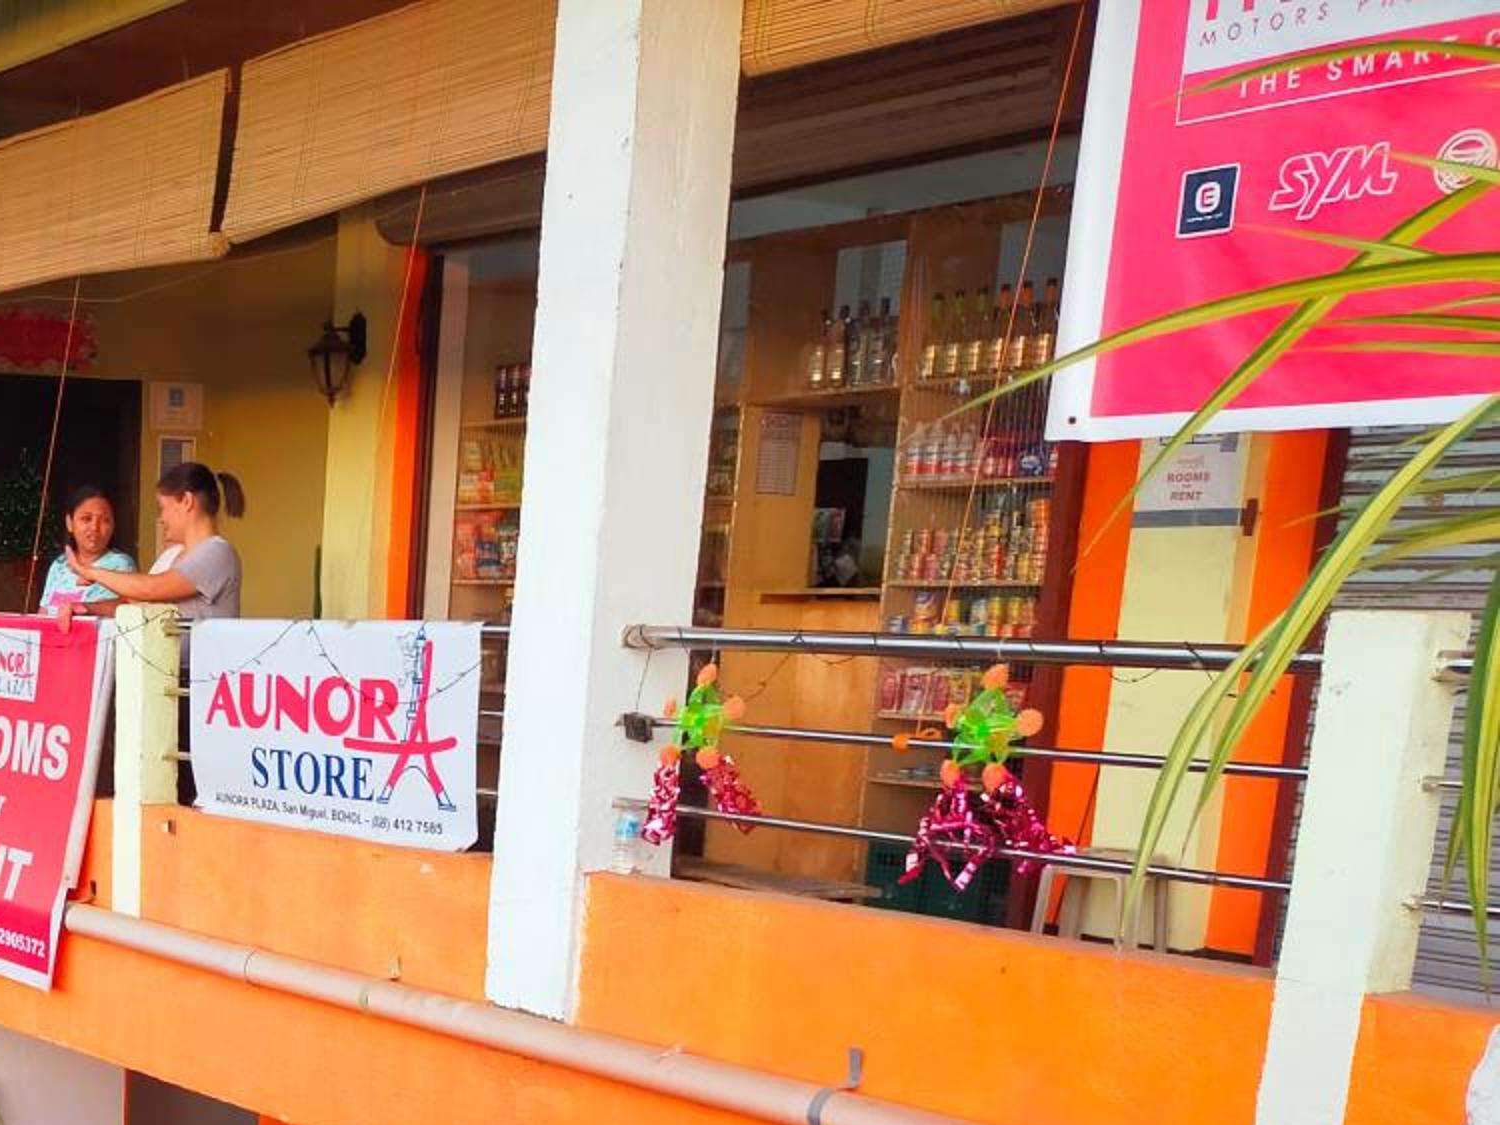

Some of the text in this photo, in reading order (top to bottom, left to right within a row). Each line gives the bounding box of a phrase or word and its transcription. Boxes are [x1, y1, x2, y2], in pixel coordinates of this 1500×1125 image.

[1199, 2, 1328, 46] MOTORS
[1239, 67, 1301, 98] THE
[1268, 141, 1398, 221] SYM
[251, 747, 374, 802] STORE
[282, 802, 298, 815] San
[331, 808, 362, 825] BOHOL
[393, 817, 413, 833] 412
